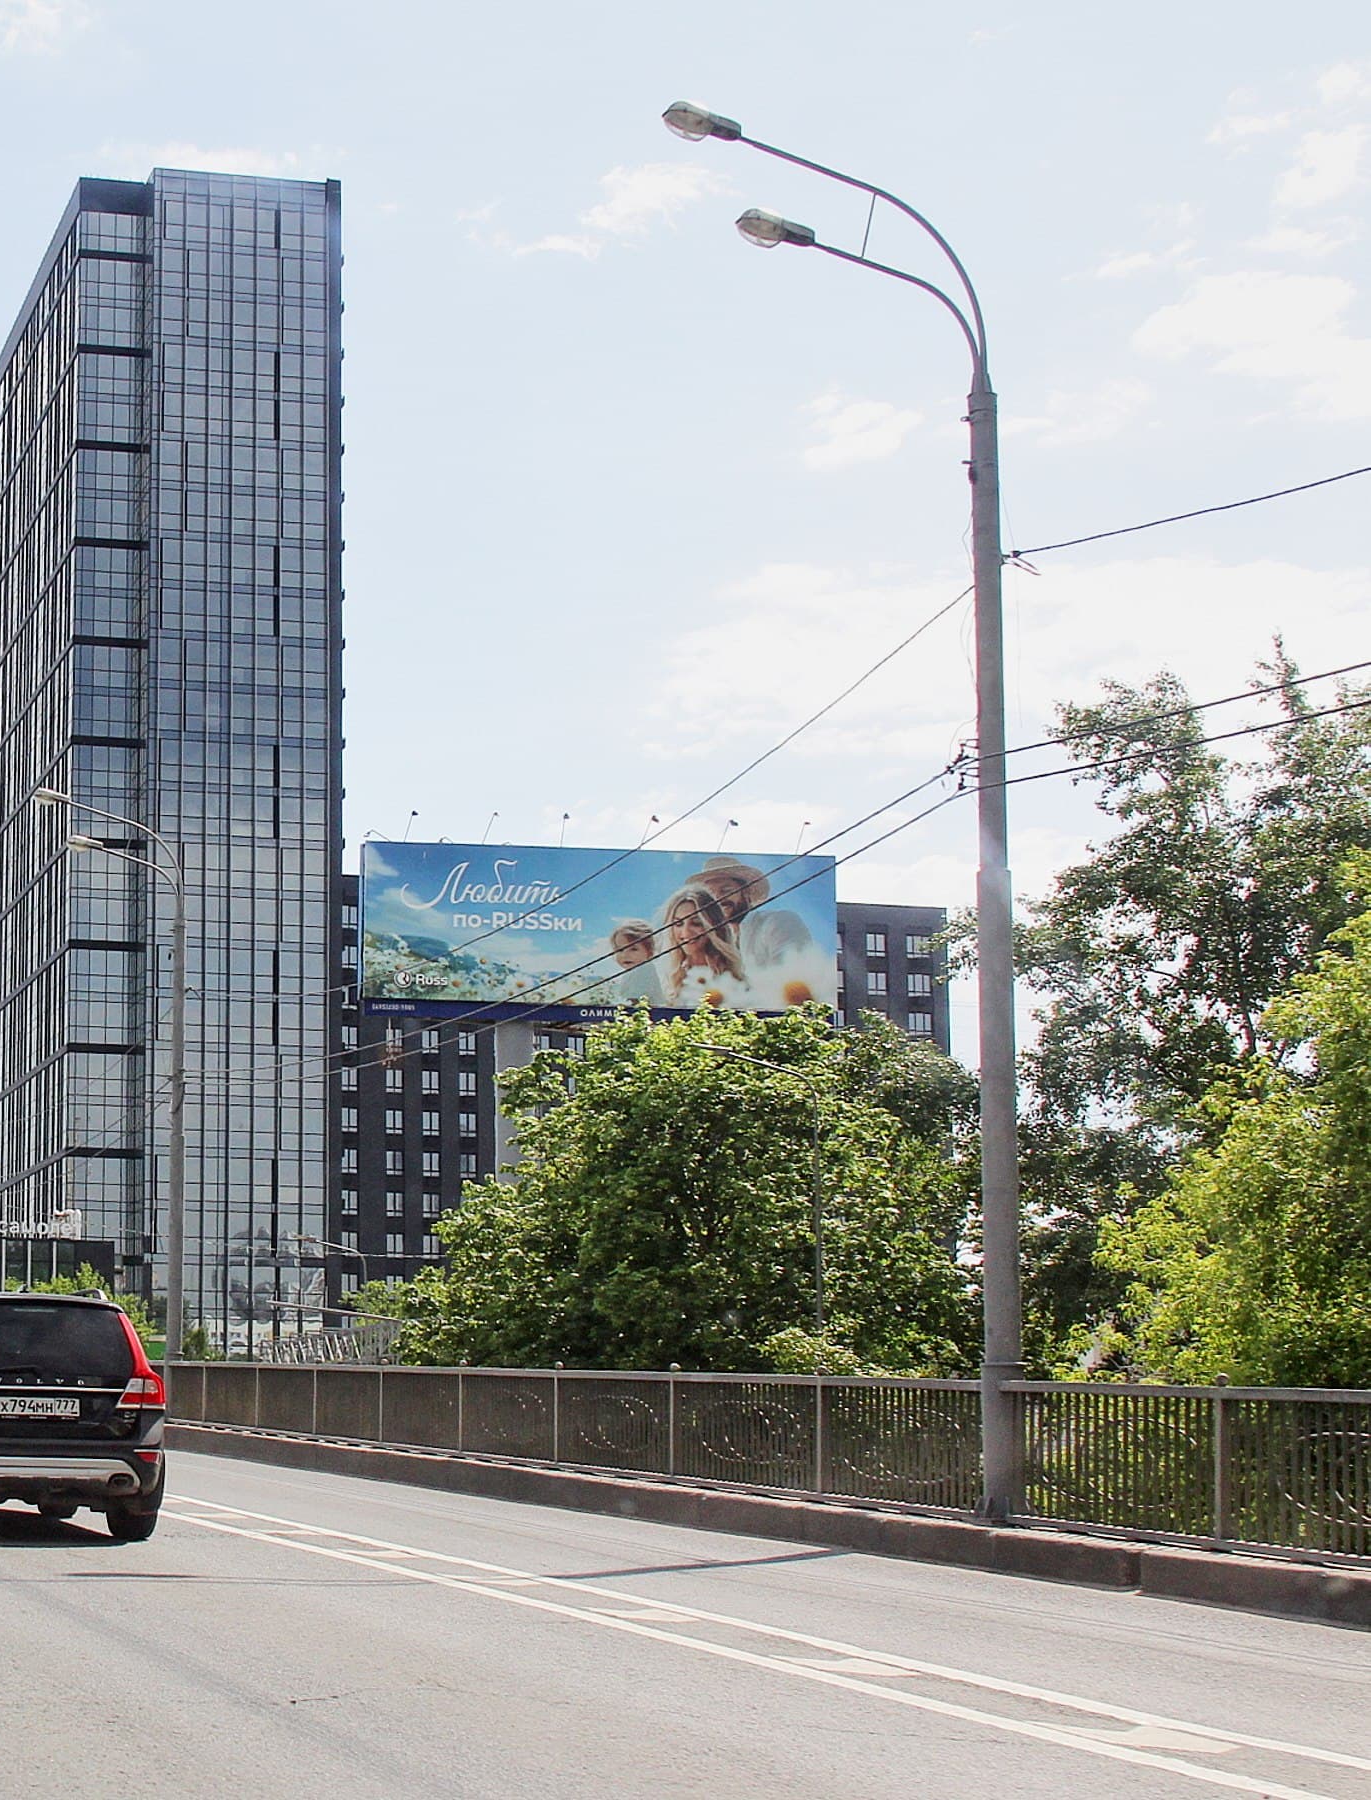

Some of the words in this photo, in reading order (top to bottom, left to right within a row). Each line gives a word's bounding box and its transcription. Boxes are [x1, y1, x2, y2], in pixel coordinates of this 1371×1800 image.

[400, 858, 567, 910] Любить
[453, 911, 582, 932] по-RUSSки
[416, 973, 448, 986] Russ
